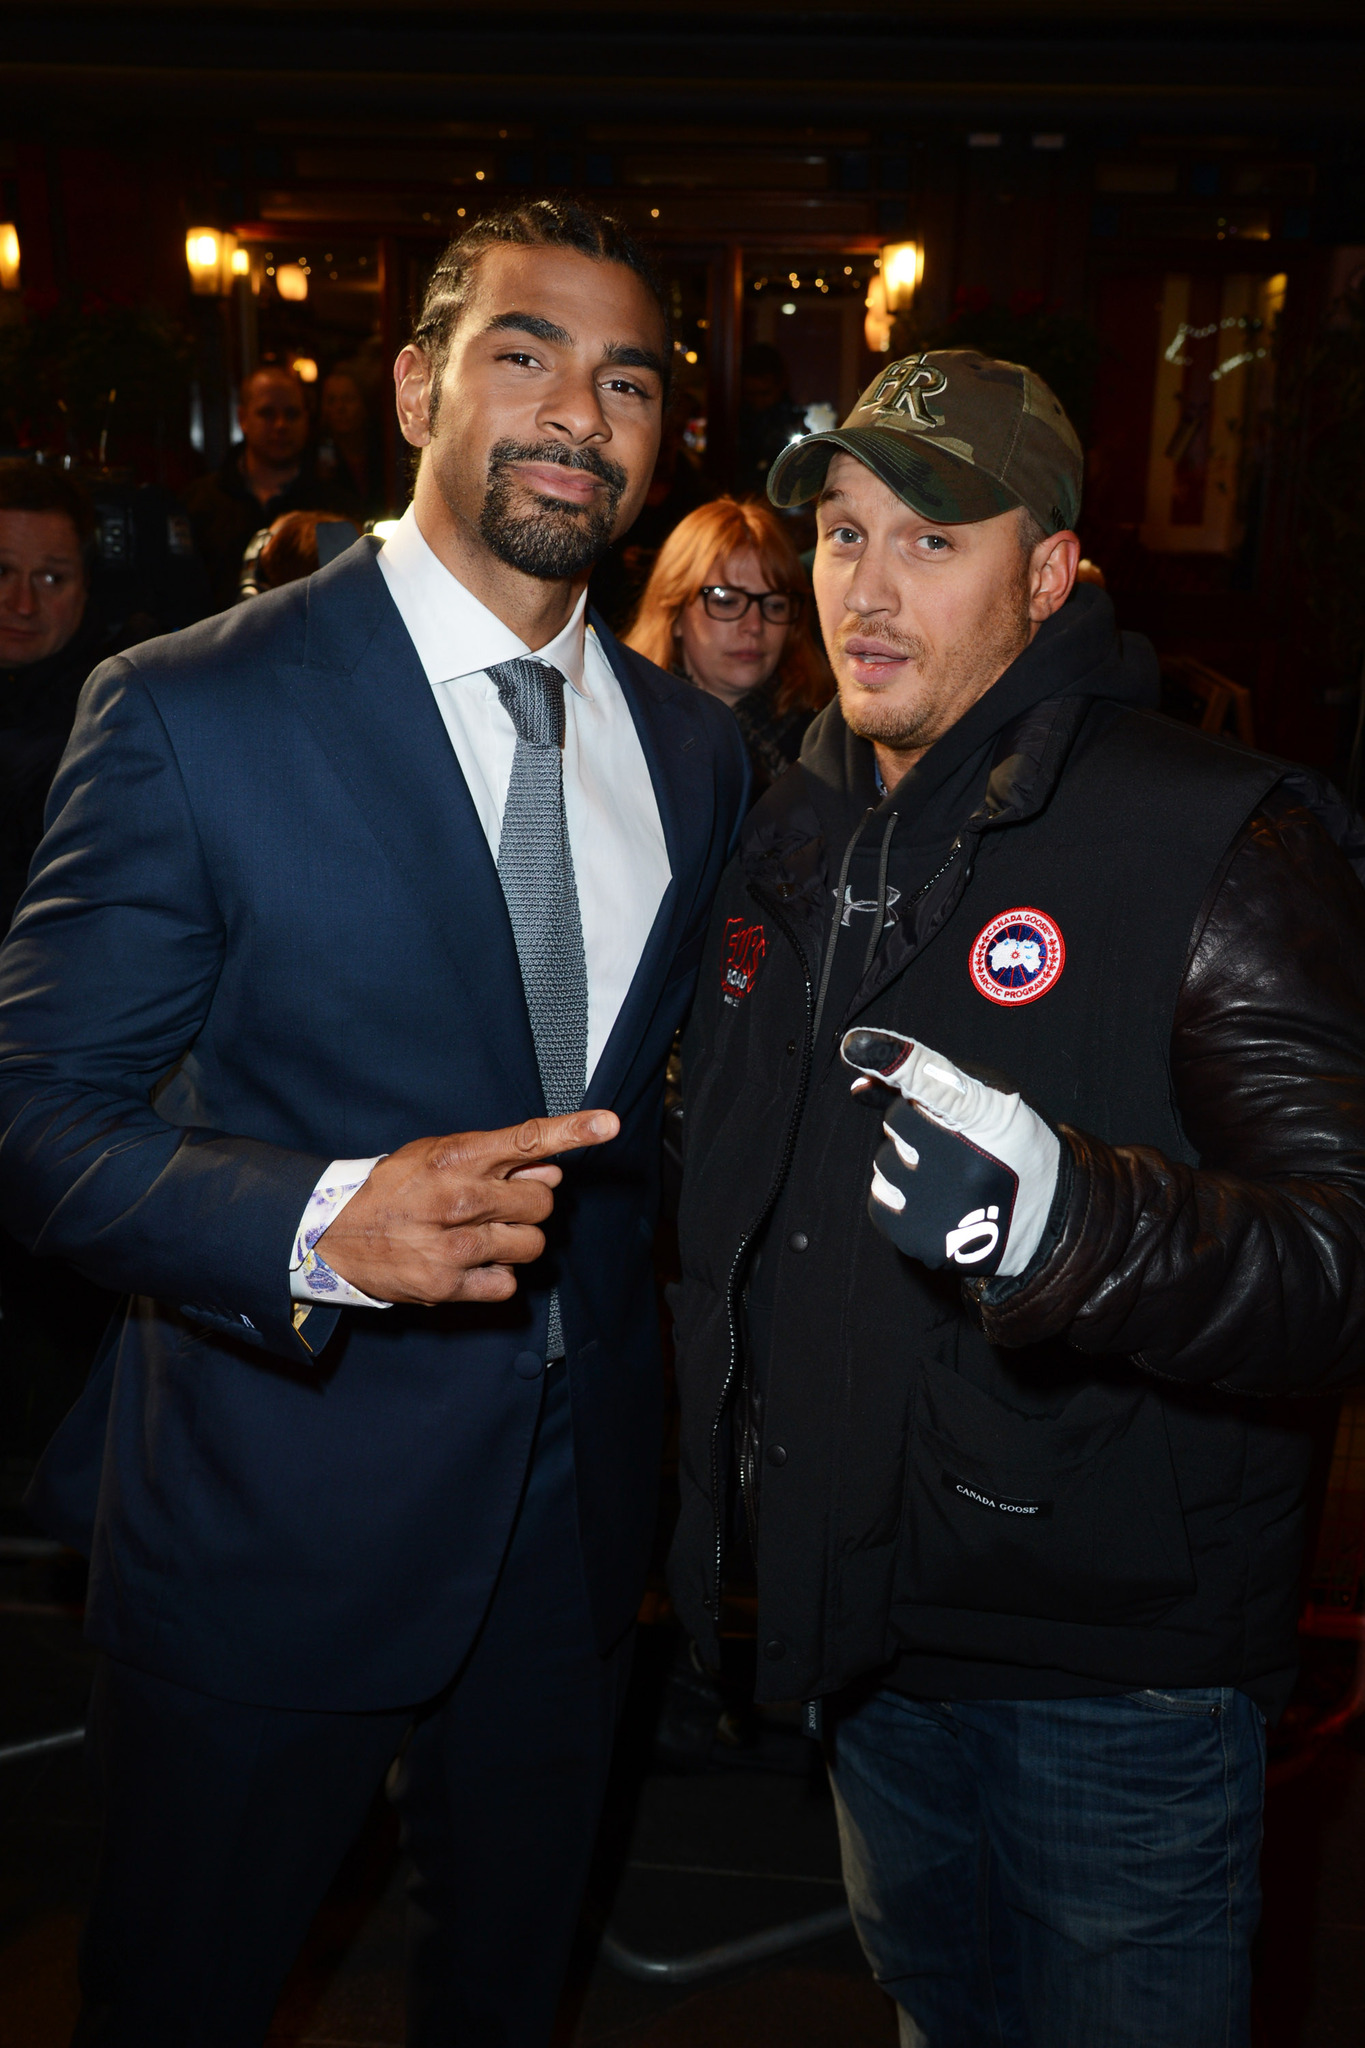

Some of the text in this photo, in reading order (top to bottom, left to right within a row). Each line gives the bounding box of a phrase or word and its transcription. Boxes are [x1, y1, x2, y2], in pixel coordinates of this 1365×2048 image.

[987, 914, 1022, 936] CANADA
[978, 974, 1047, 998] ARCTIC PROGRAM
[956, 1484, 996, 1508] CANADA
